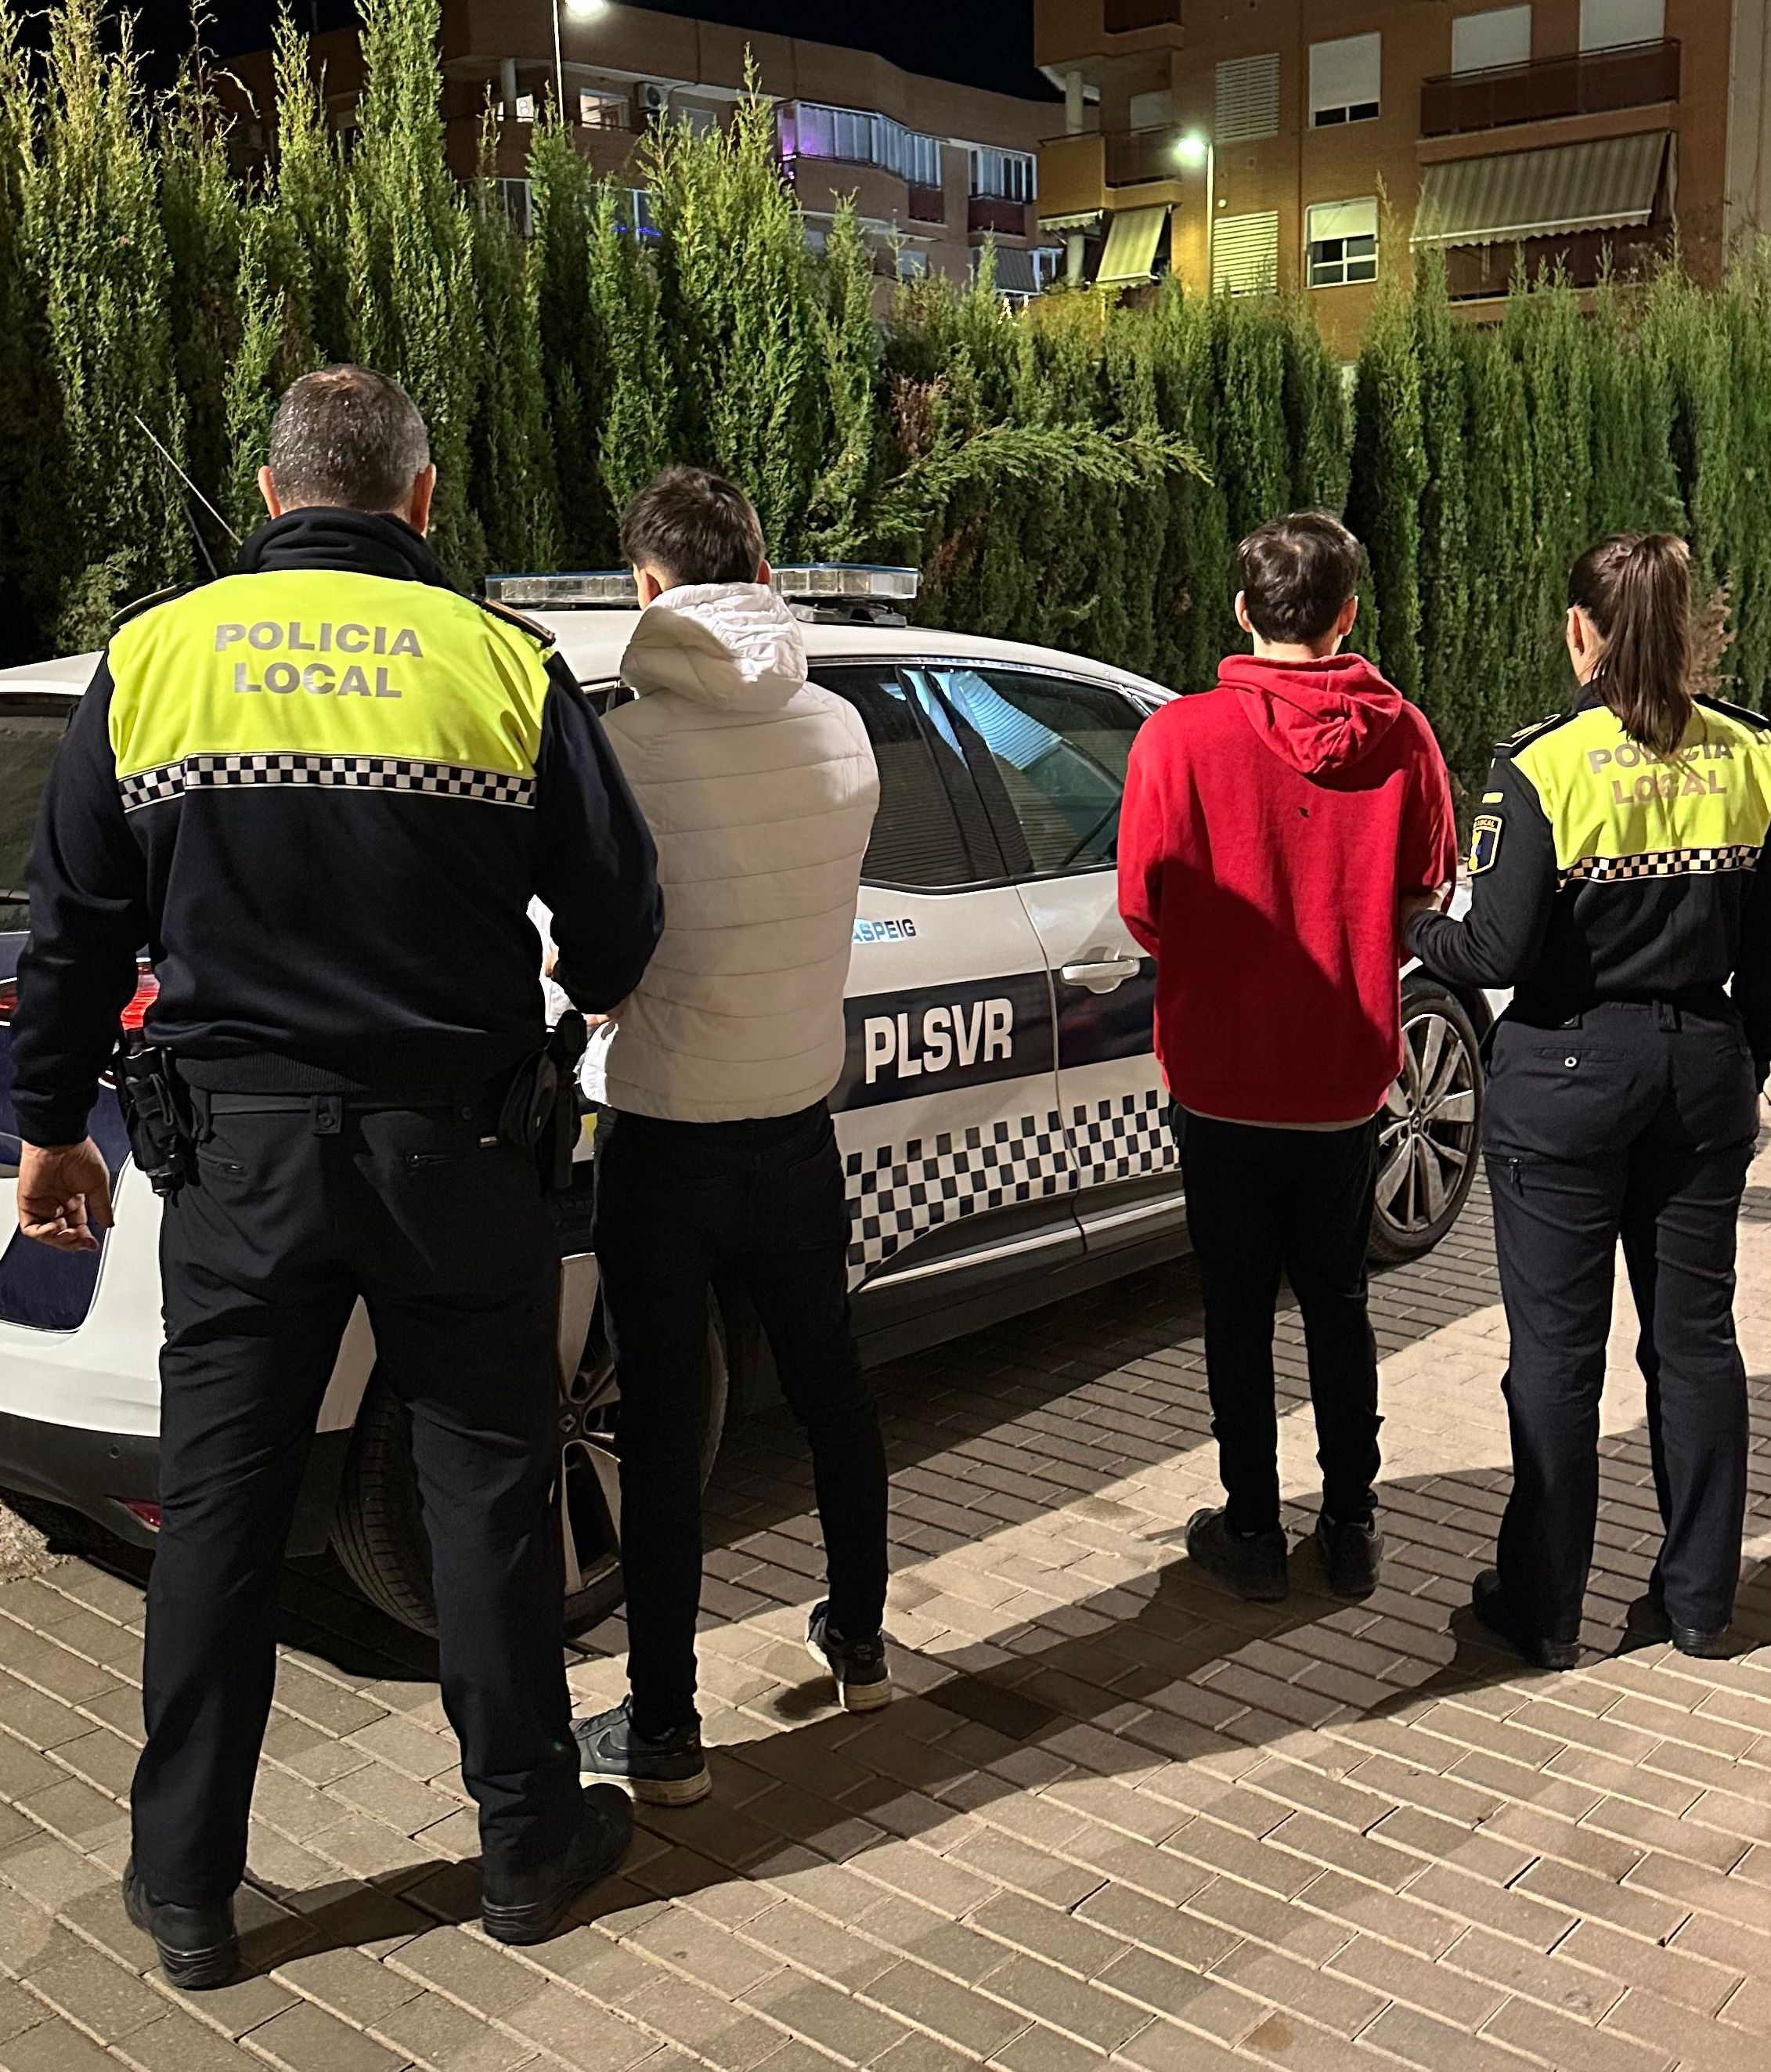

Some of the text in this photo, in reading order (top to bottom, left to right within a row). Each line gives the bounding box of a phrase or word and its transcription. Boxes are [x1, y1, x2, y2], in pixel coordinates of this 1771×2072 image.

[215, 621, 424, 658] POLICIA
[234, 662, 402, 698] LOCAL
[1612, 770, 1727, 805] LOCAL
[864, 998, 1014, 1085] PLSVR
